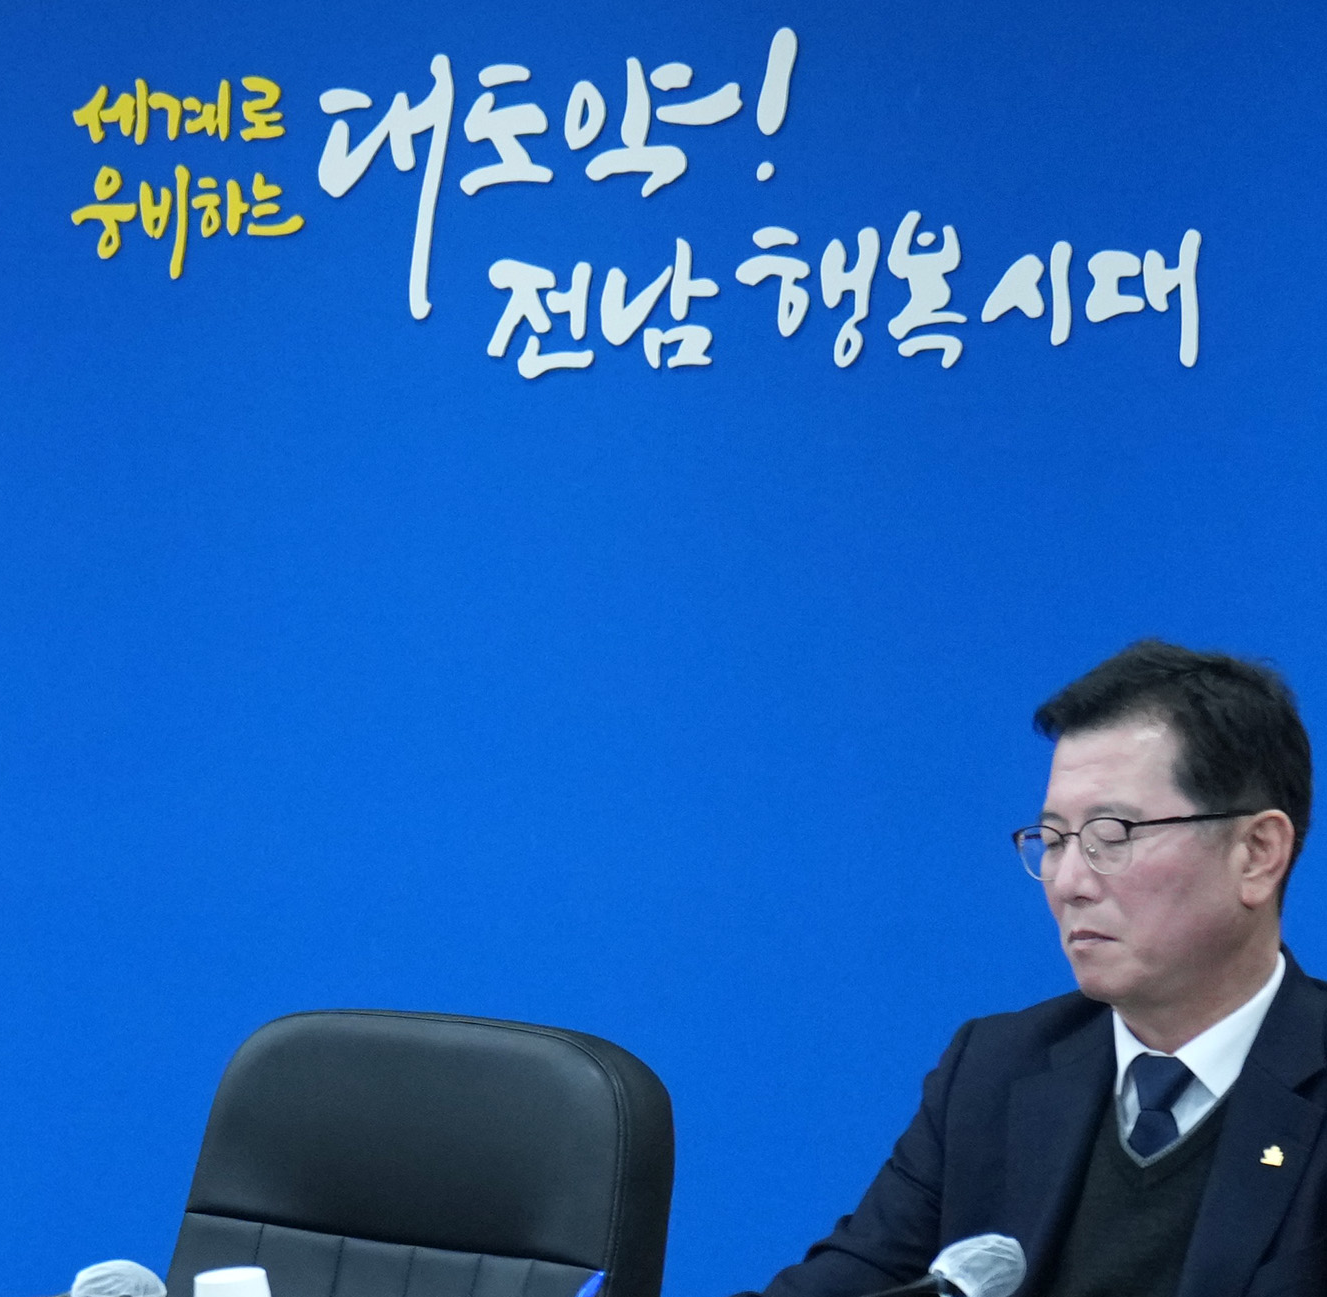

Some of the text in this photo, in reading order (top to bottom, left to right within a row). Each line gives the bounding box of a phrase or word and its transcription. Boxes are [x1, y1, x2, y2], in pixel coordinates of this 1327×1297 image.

[72, 76, 285, 145] 세계로
[319, 28, 797, 320] 대도약!
[71, 165, 304, 280] 웅비하는
[486, 237, 719, 379] 전남
